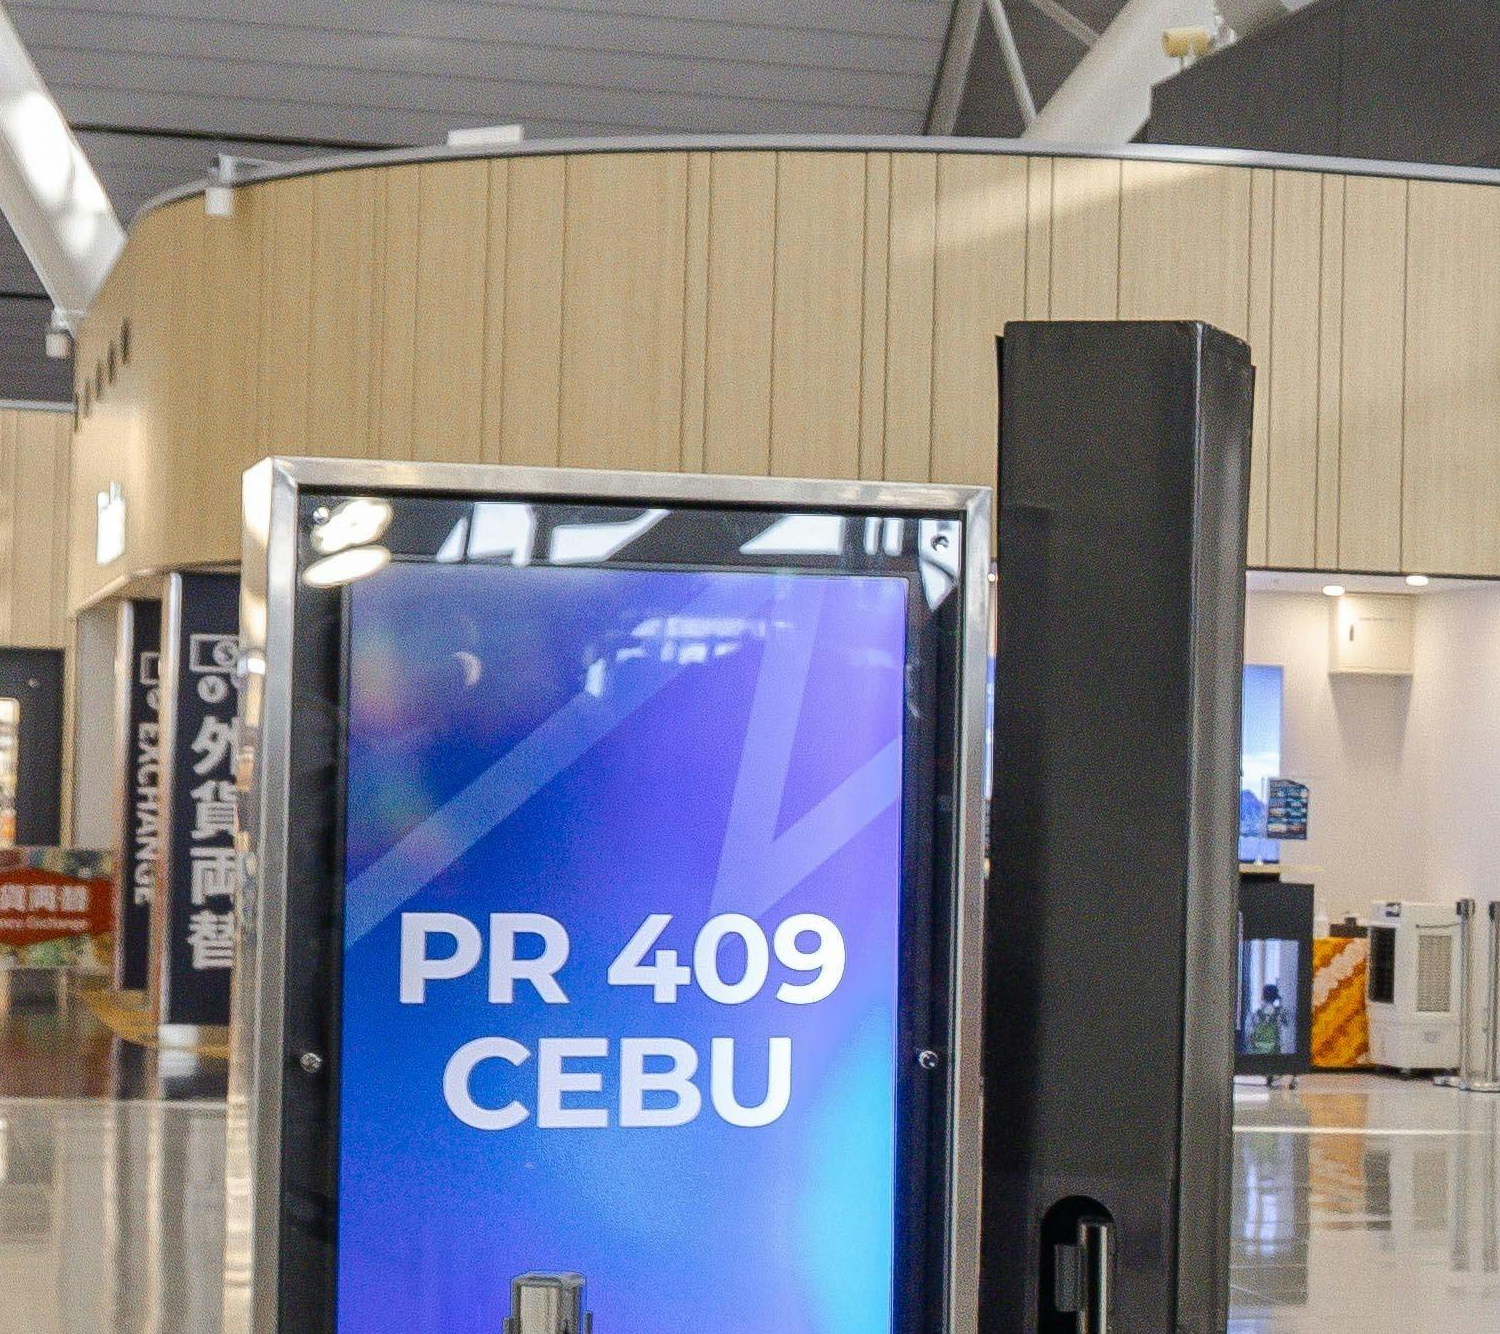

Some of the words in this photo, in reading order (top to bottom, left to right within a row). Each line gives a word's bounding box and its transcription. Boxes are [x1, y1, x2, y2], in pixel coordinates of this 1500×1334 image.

[400, 912, 570, 1005] PR
[607, 913, 846, 1005] 409
[443, 1036, 792, 1130] CEBU
